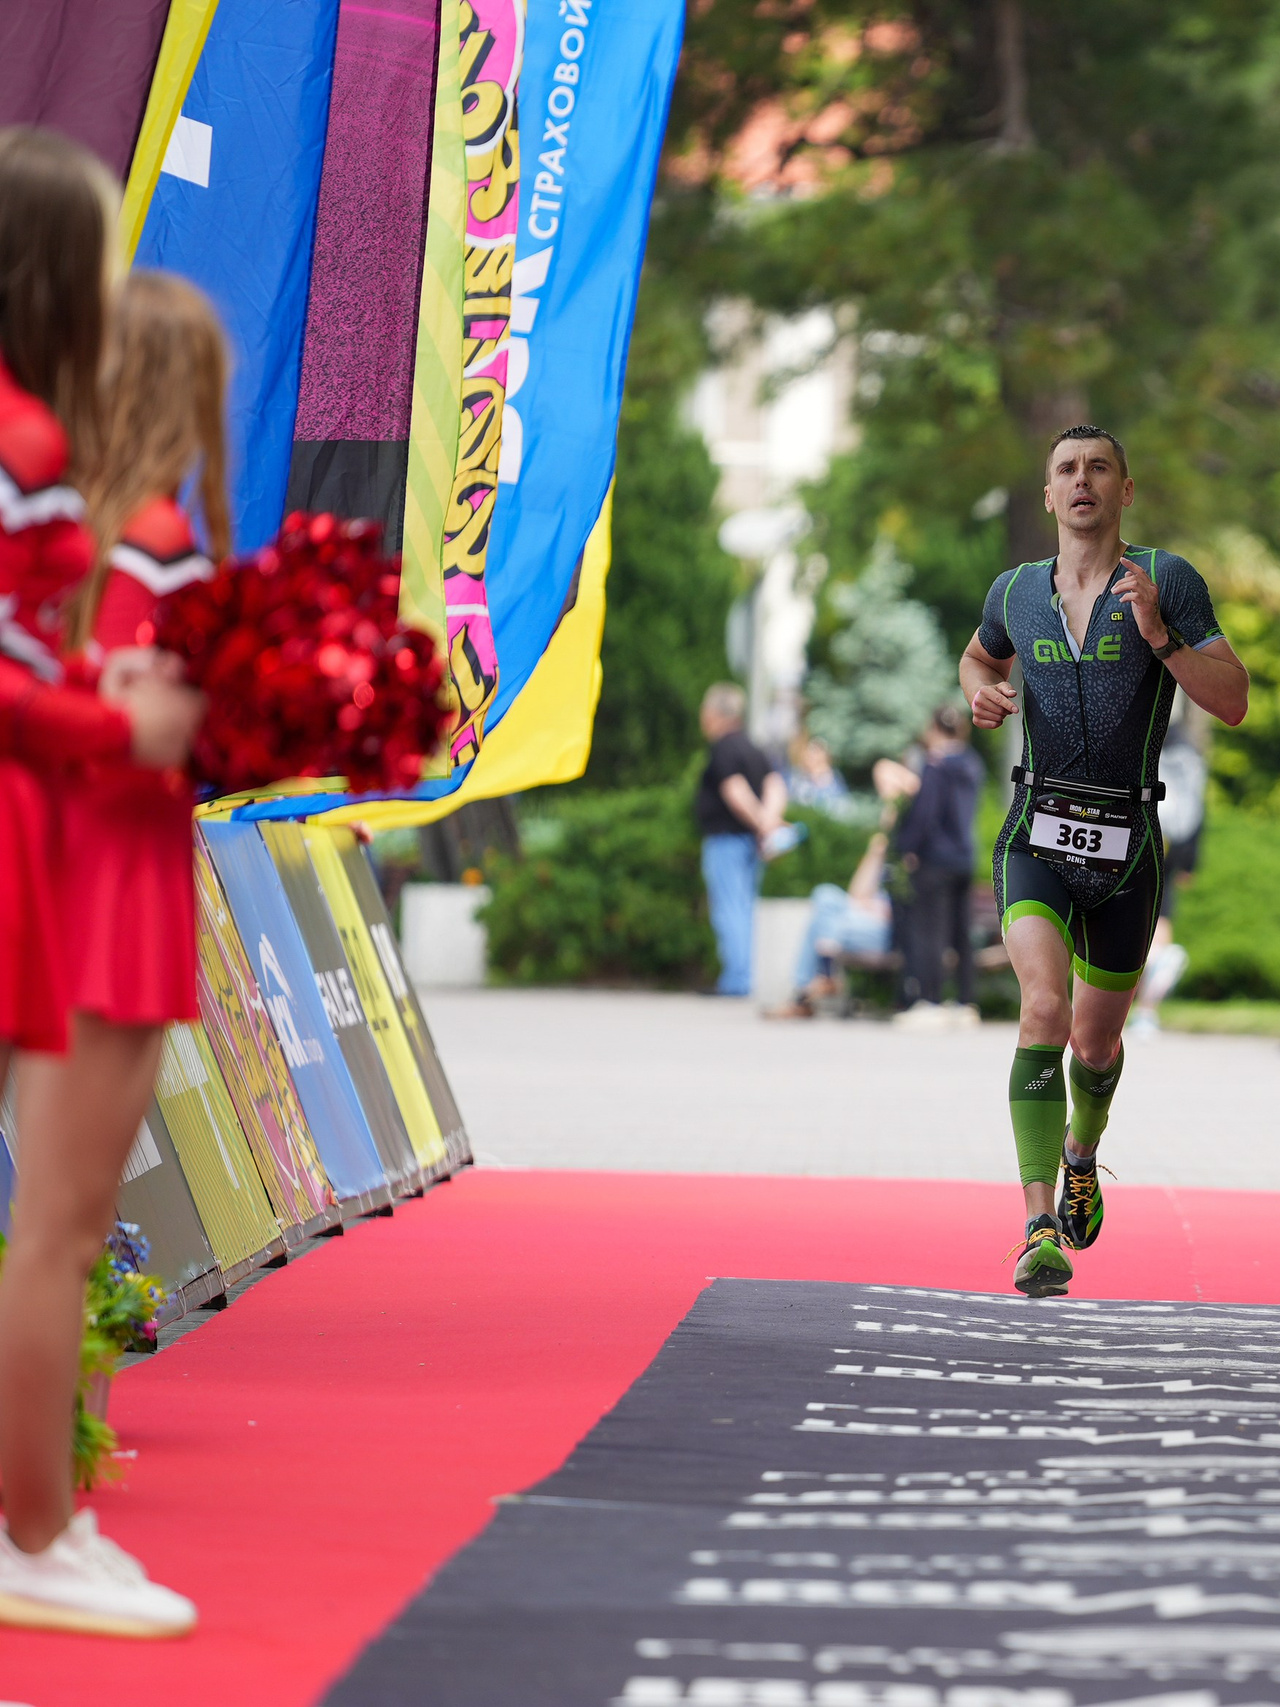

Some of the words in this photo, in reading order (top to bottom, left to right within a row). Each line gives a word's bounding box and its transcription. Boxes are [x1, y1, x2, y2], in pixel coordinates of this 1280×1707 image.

[528, 0, 593, 241] СТРАХОВОЙ
[1087, 807, 1101, 816] STAR
[1056, 823, 1103, 853] 363
[1066, 855, 1086, 865] DENIS
[832, 1363, 1103, 1386] IRON
